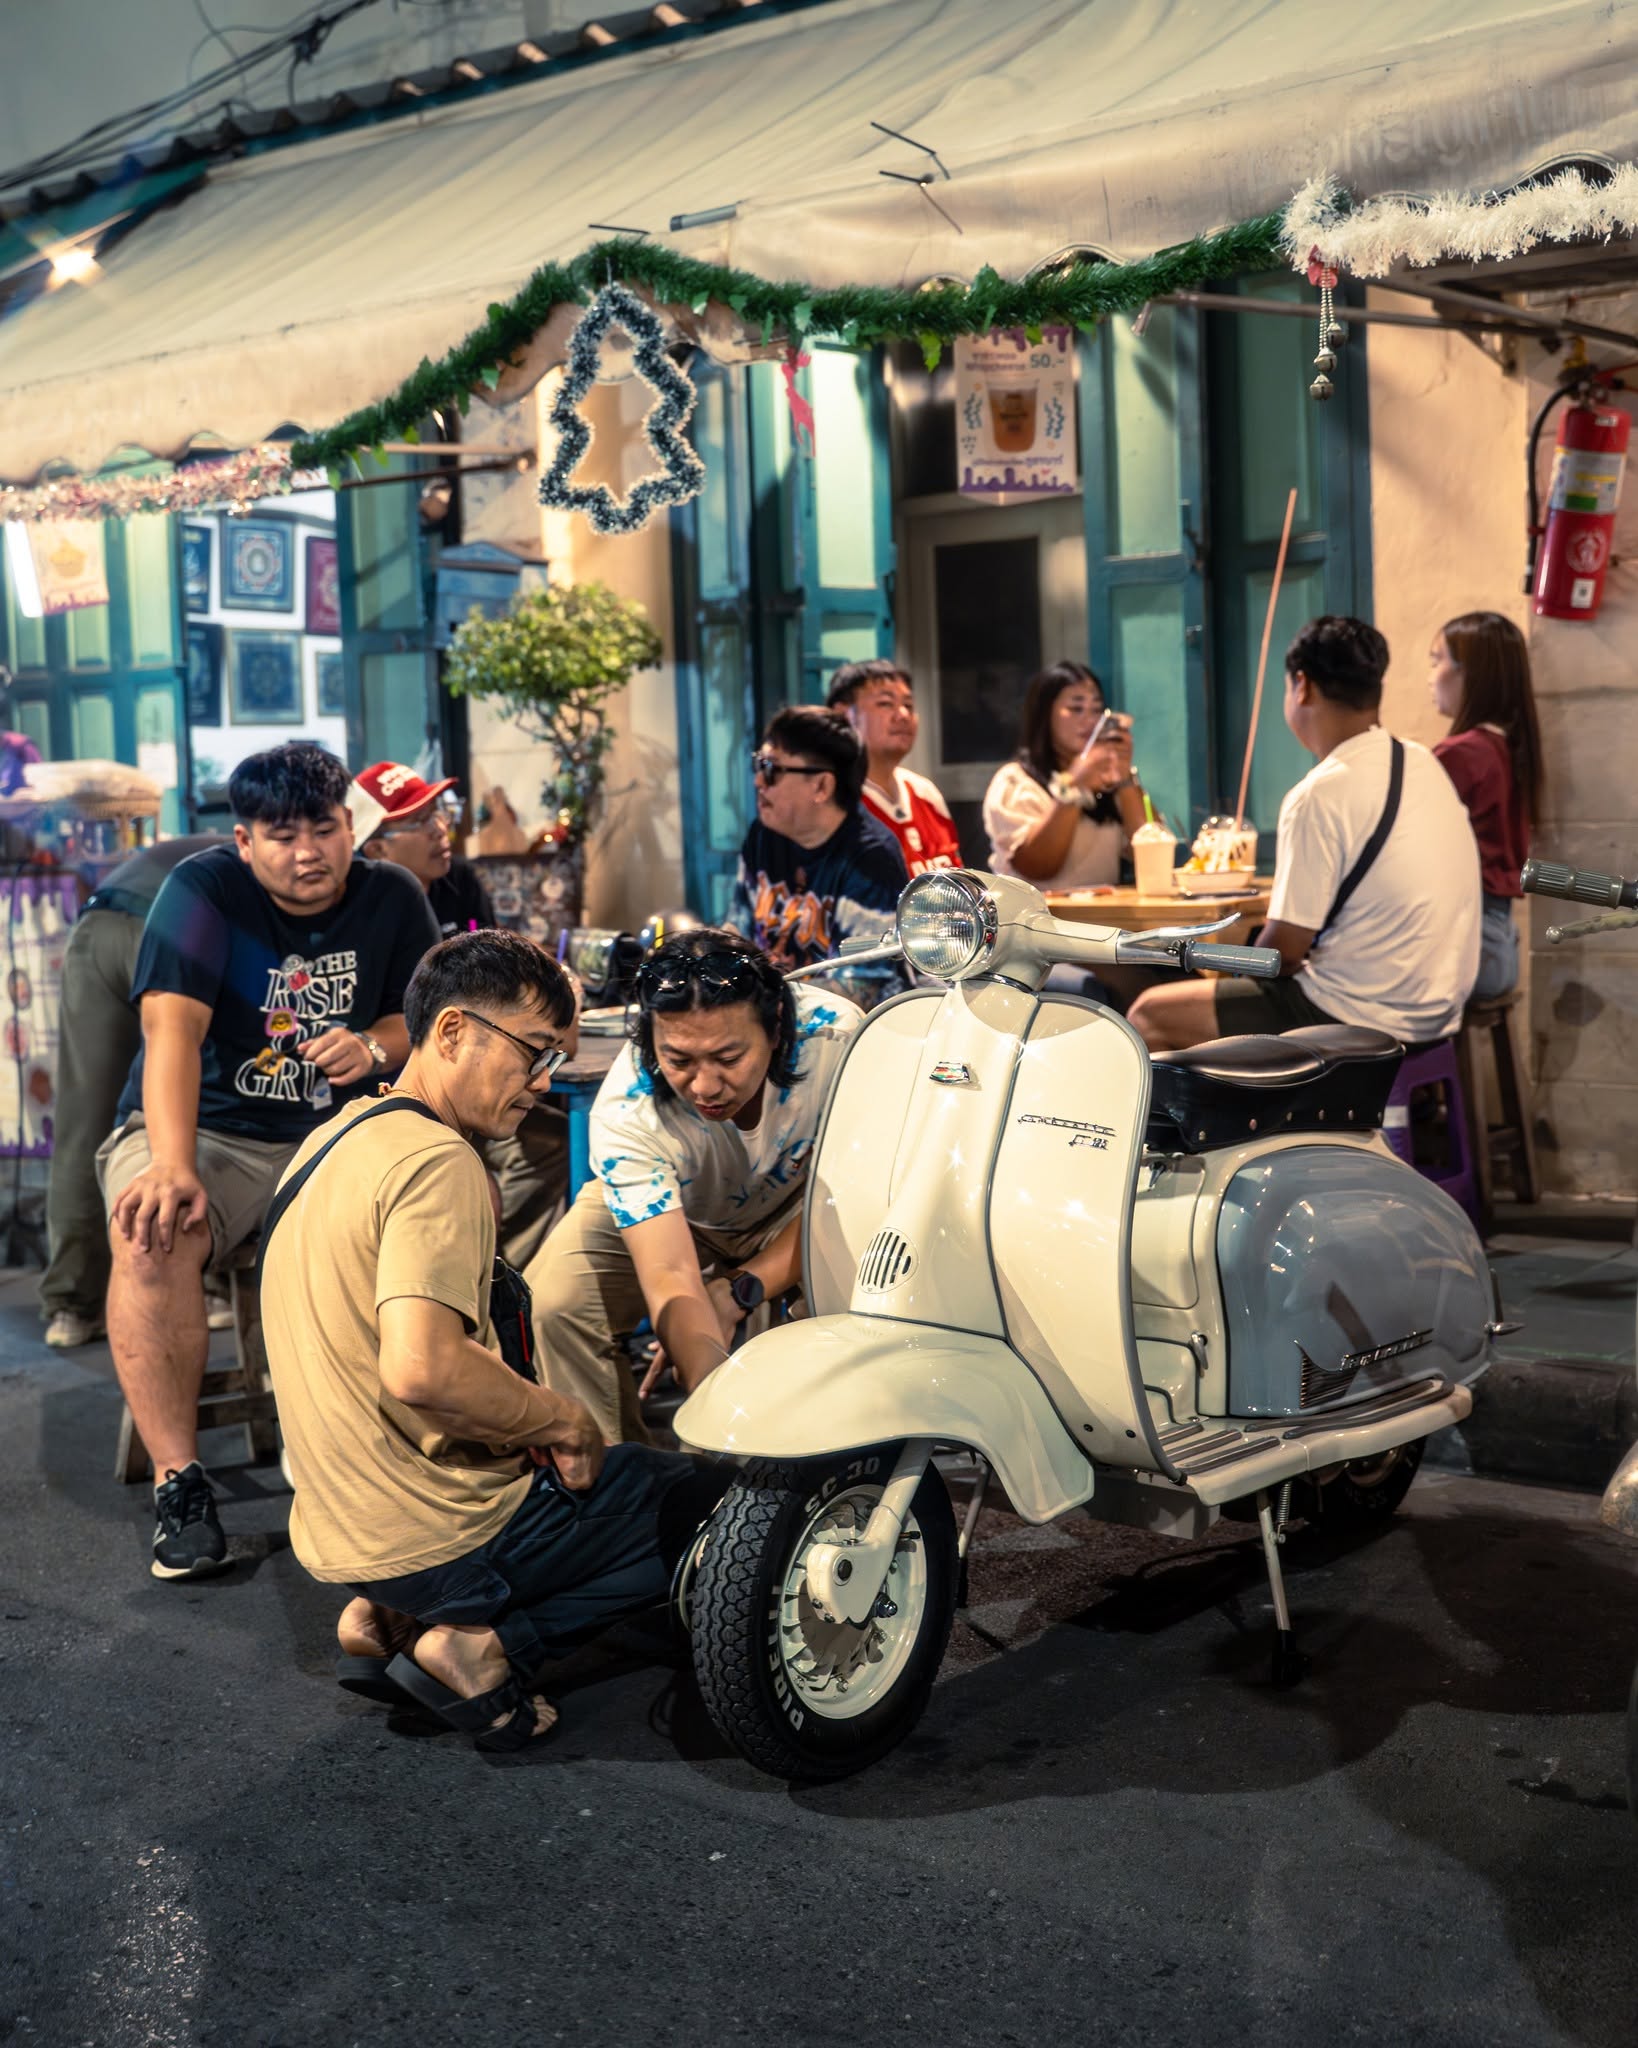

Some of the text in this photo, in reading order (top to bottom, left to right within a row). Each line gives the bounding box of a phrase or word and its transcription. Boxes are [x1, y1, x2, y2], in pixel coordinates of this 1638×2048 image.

[315, 950, 358, 975] THE
[803, 1475, 839, 1519] SC
[768, 1584, 805, 1732] PIRELLI
